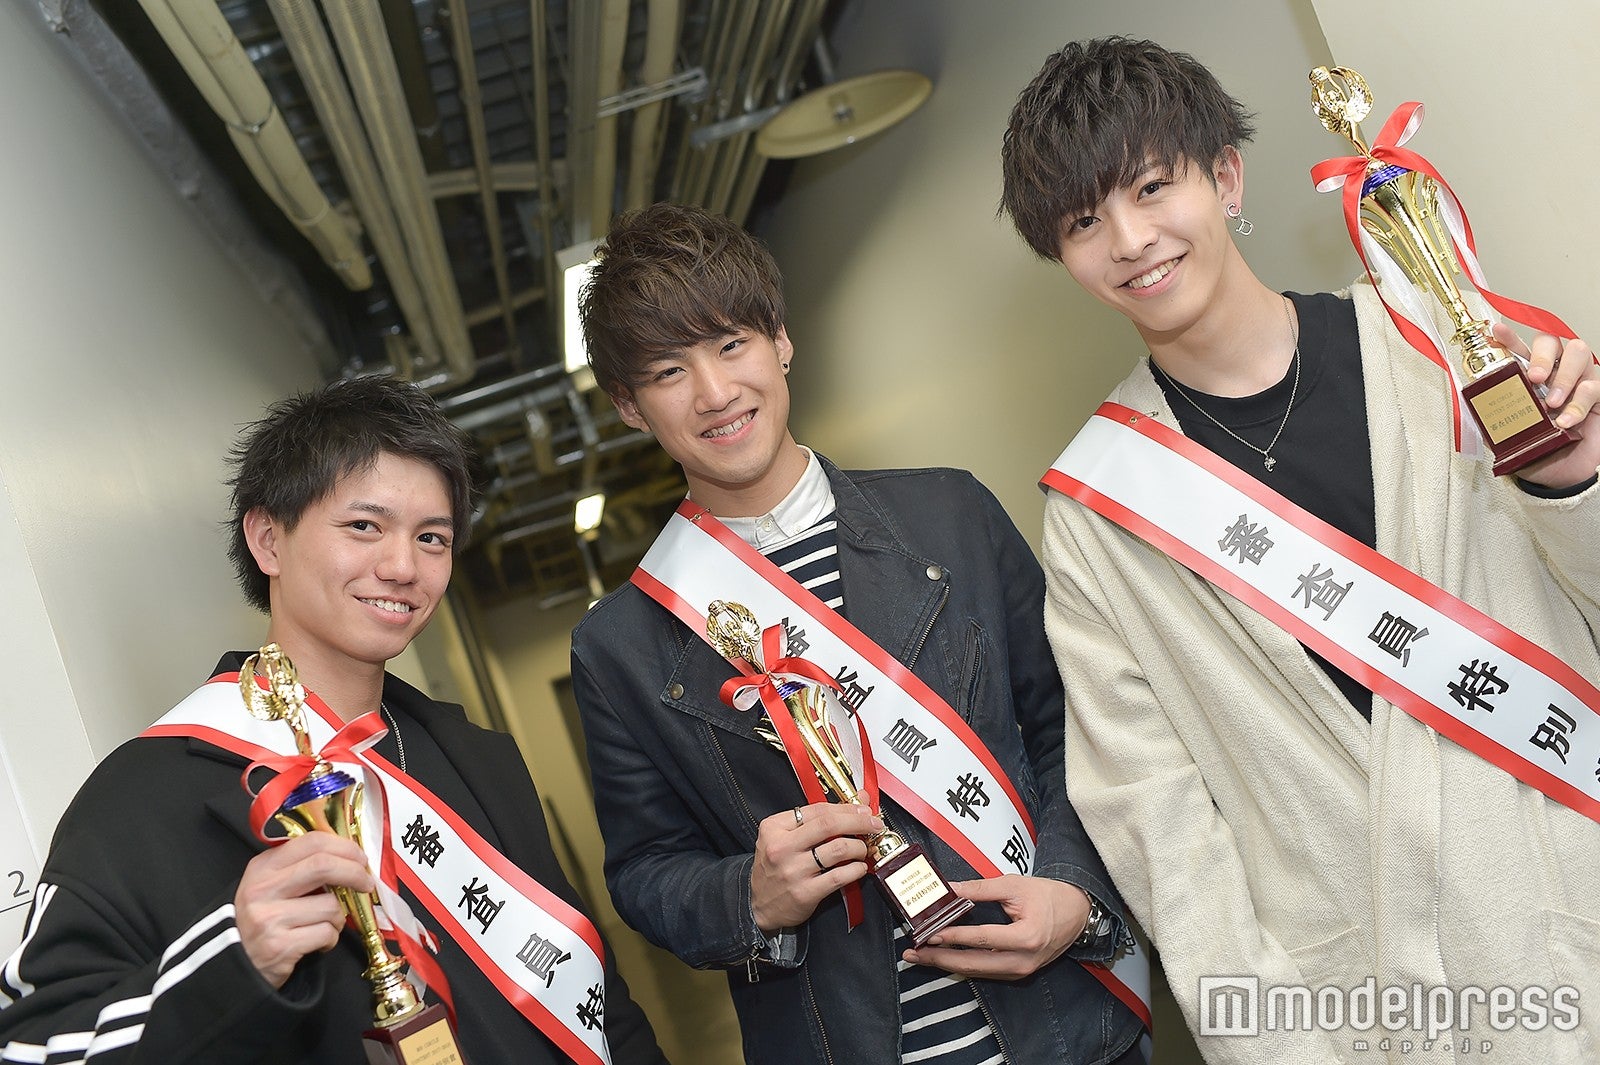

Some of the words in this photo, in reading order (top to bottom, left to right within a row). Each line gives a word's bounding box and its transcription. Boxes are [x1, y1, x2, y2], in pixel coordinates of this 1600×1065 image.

[1218, 513, 1600, 783] 審査員特別
[7, 870, 30, 898] 2
